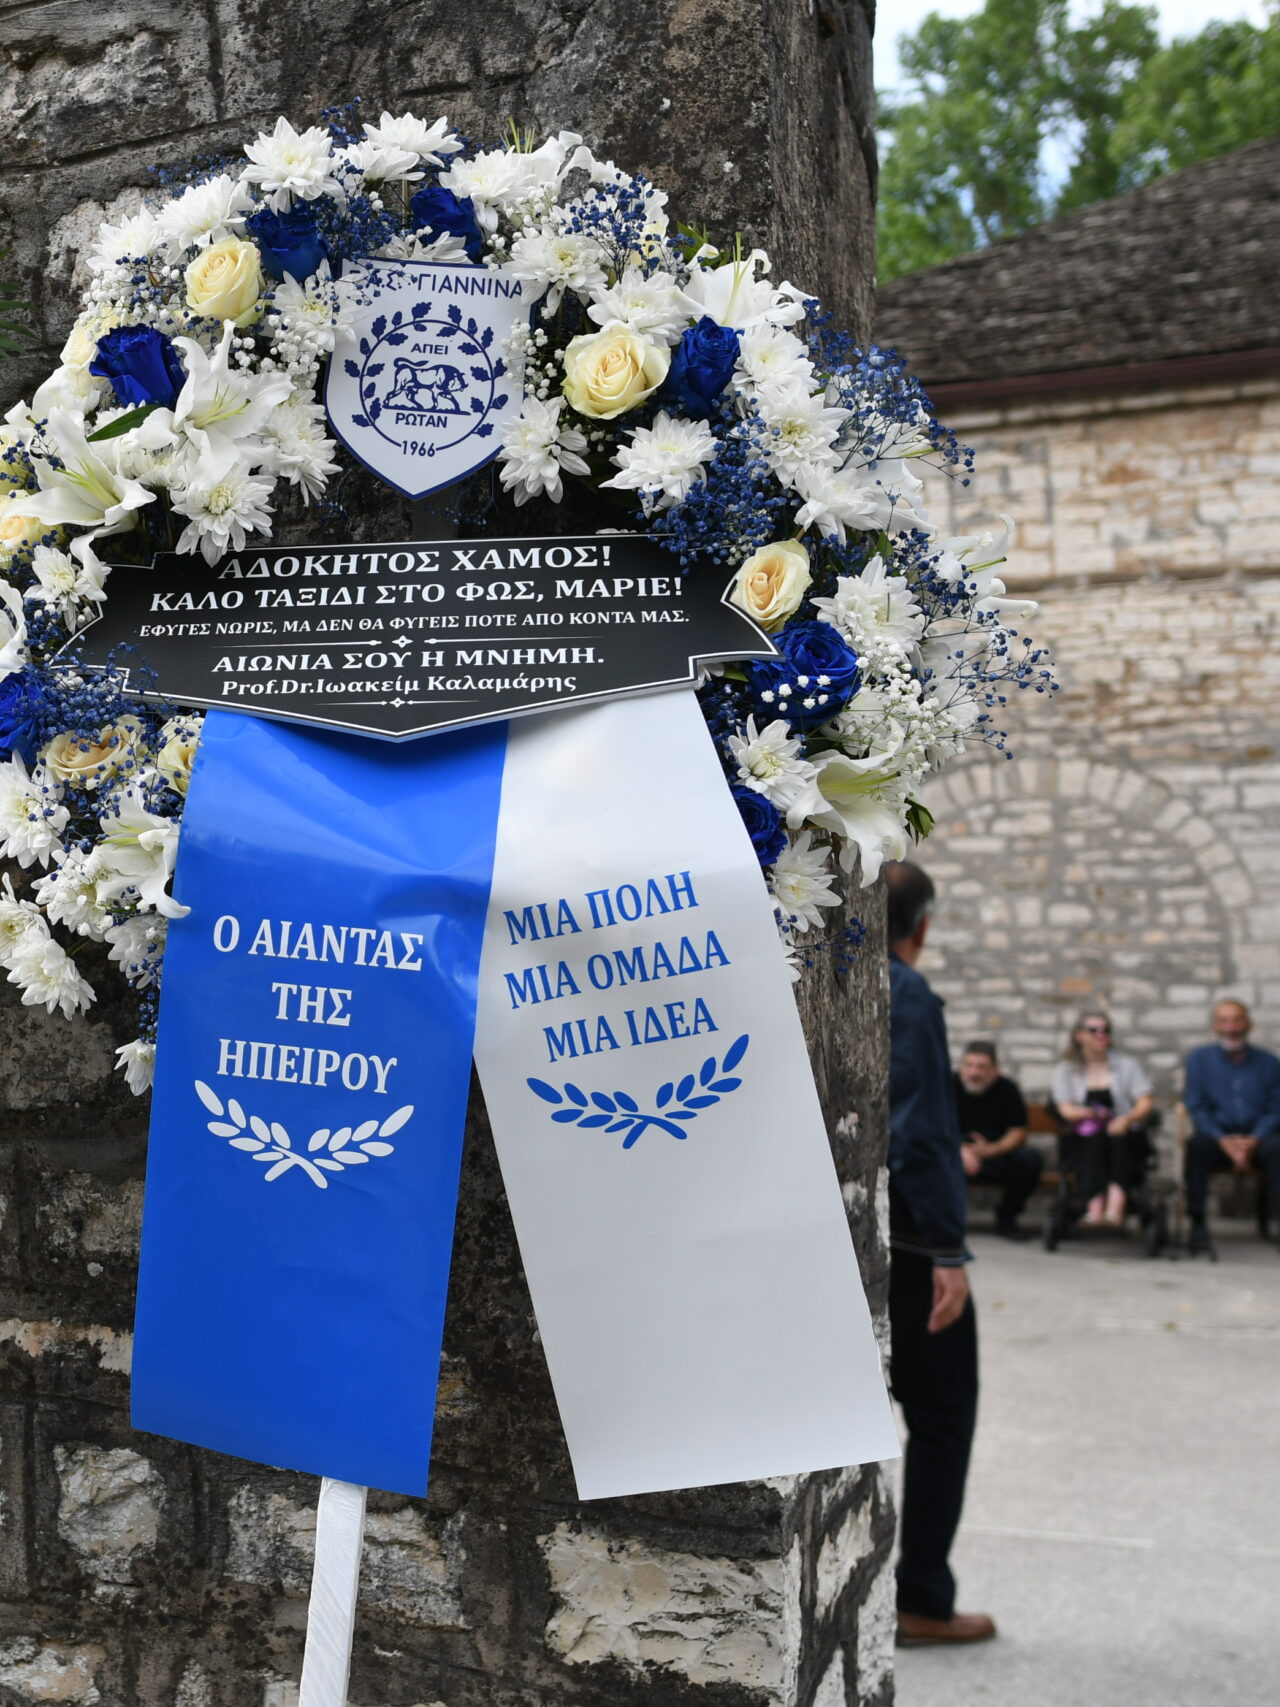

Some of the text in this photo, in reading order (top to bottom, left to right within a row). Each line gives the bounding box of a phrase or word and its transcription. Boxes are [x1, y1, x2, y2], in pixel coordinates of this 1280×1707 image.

[417, 273, 522, 299] ΓΙΑΝΝΙΝΑ
[410, 342, 449, 356] ΑΠΕΙ
[395, 412, 448, 429] ΡΩΤΑΝ
[401, 440, 436, 458] 1966
[218, 545, 611, 579] ΑΔΟΚΗΤΟΣ ΧΑΜΟΣ!
[149, 576, 682, 612] ΚΑΛΟ ΤΑΞΙΔΙ ΣΤΟ ΦΩΣ, ΜΑΡΙΕ!
[139, 609, 690, 638] ΕΦΥΓΕΣ ΝΩΡΙΣ, ΜΑ ΔΕΝ ΘΑ ΦΥΓΕΙΣ ΠΟΤΕ ΑΠΟ ΚΟΝΤΑ ΜΑΣ.
[211, 647, 605, 673] ΑΙΩΝΙΑ ΣΟΥ Η ΜΝΗΜΗ.
[427, 672, 577, 693] Καλαμάρης
[503, 870, 700, 946] ΜΙΑ ΠΟΛΗ
[213, 914, 424, 972] Ο ΑΙΑΝΤΑΣ
[503, 930, 732, 1010] ΜΙΑ ΟΜΑΔΑ
[271, 981, 352, 1027] ΤΗΣ
[542, 997, 720, 1064] ΜΙΑ ΙΔΕΑ
[216, 1038, 398, 1094] ΗΠΕΙΡΟΥ
